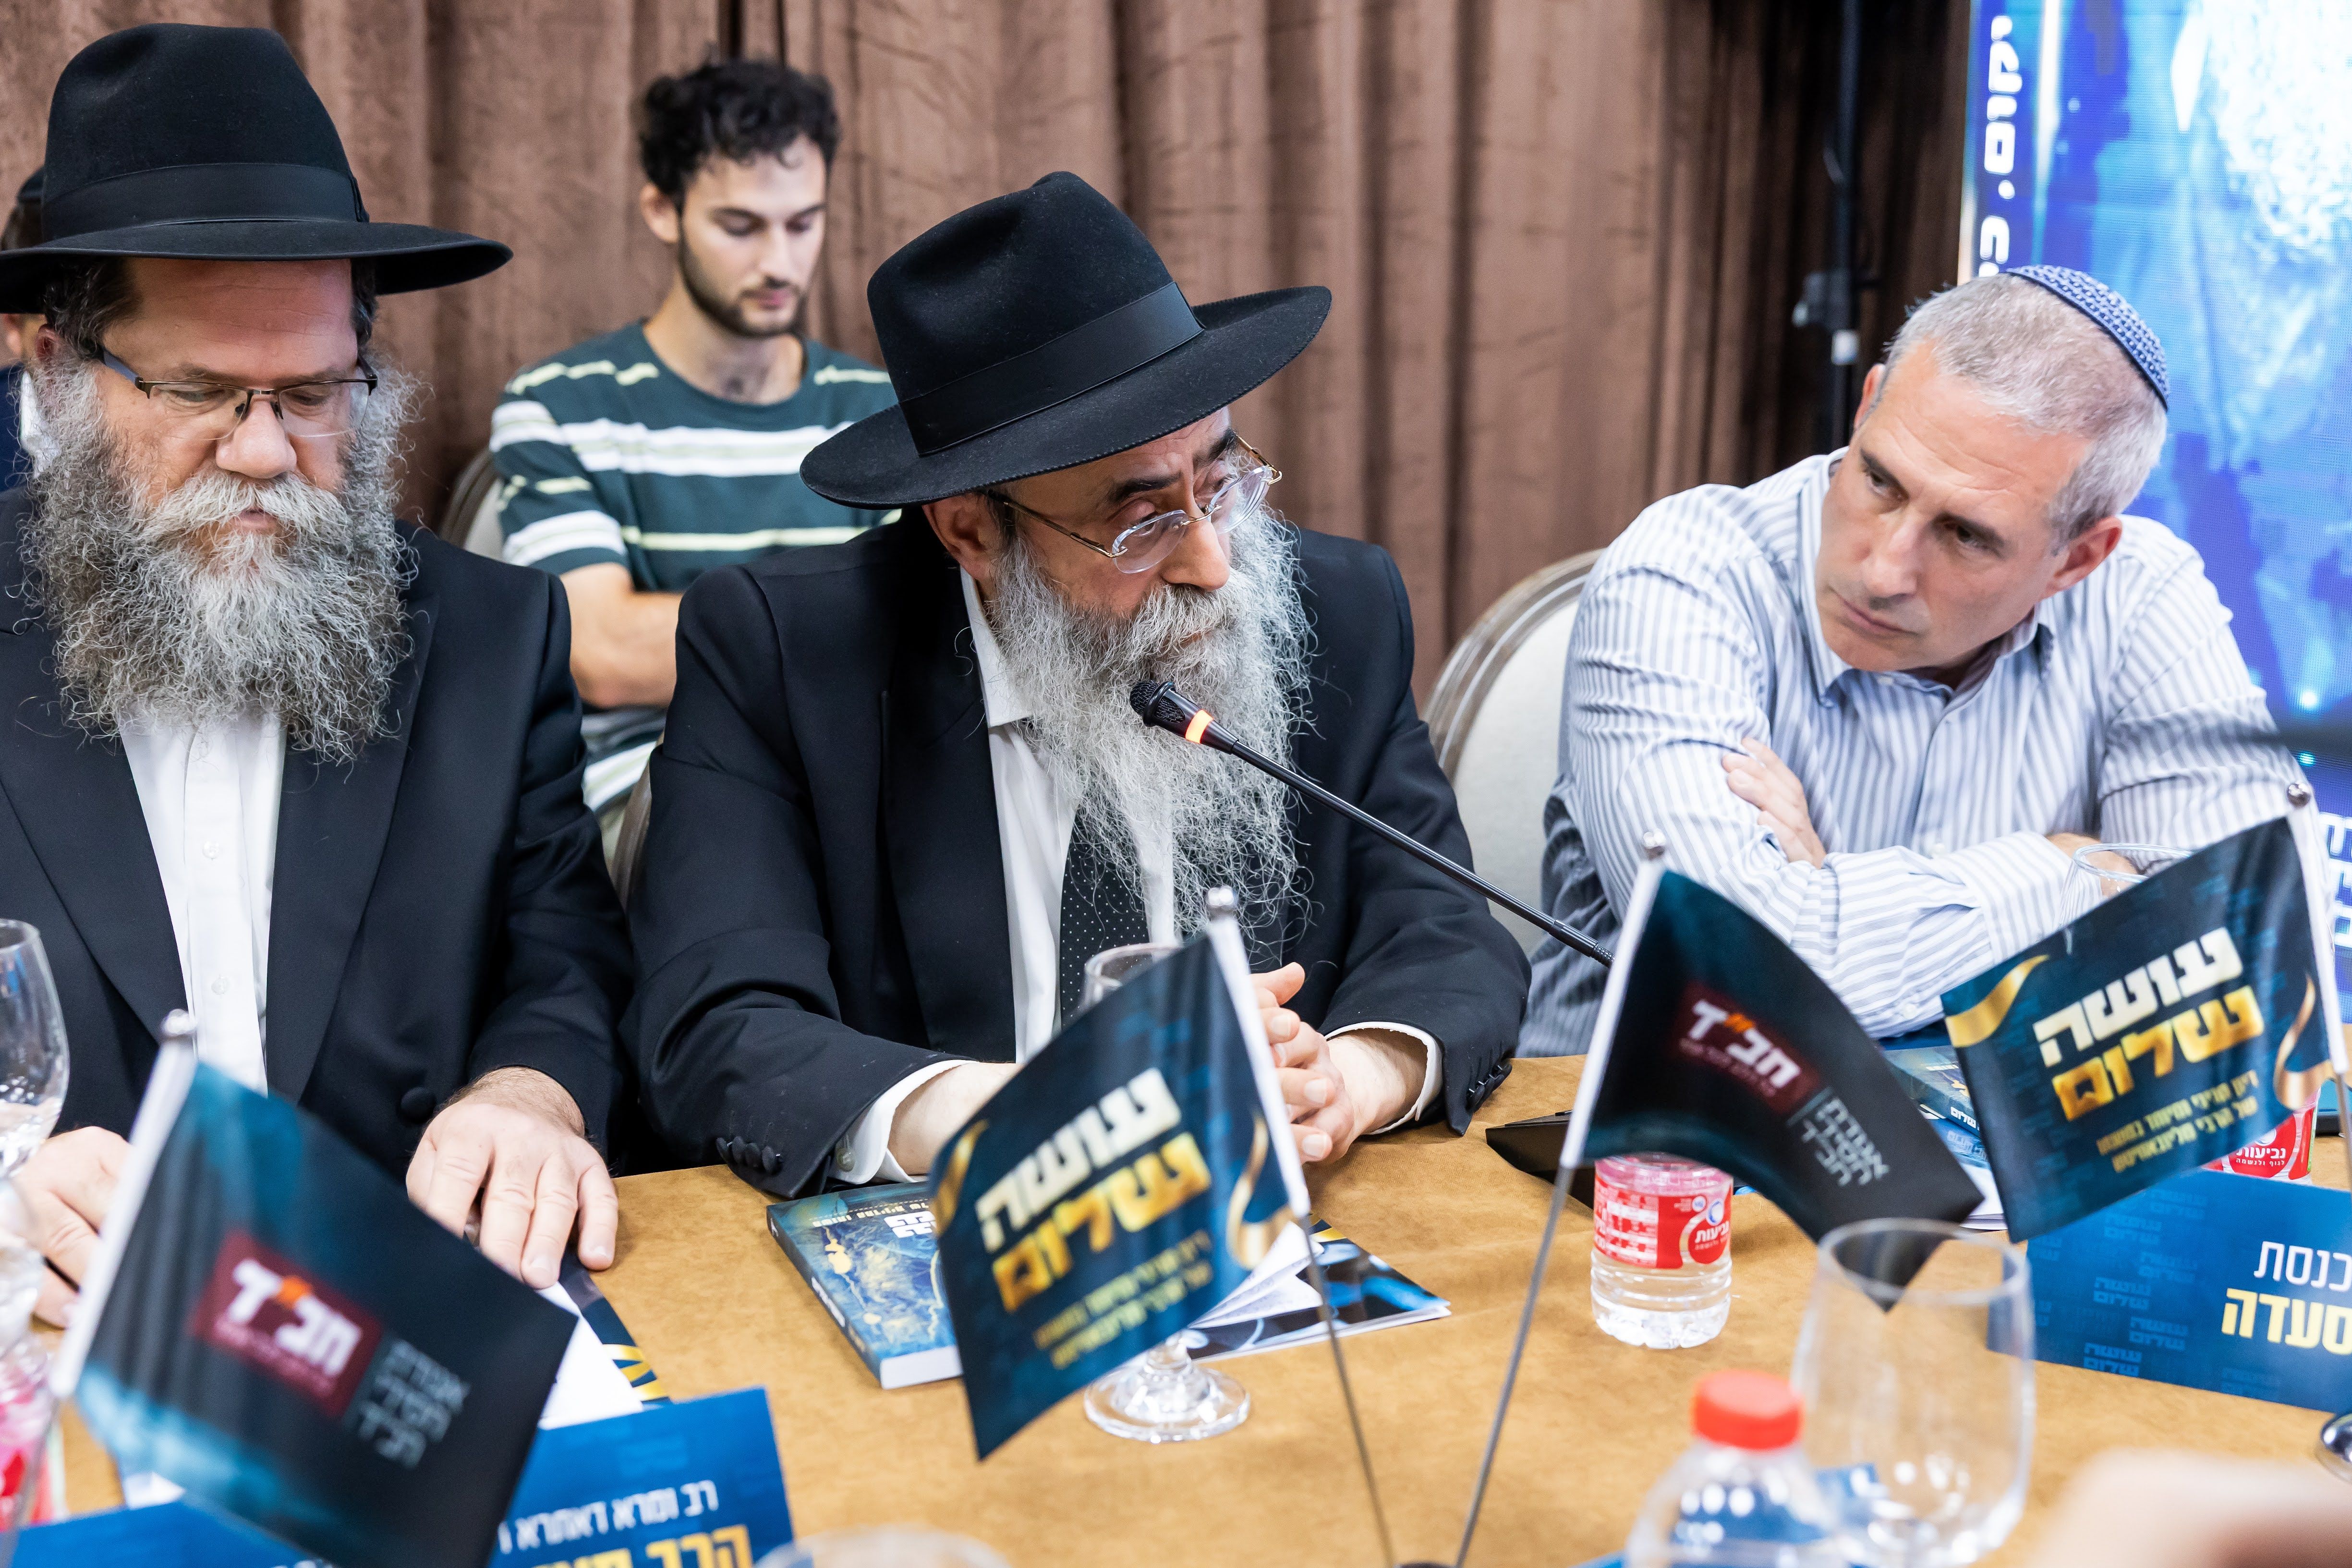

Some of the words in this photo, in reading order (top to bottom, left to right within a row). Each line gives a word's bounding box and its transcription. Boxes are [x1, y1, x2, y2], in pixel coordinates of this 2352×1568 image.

[1691, 997, 1800, 1087] חב"ד
[2033, 927, 2243, 1068] עושה
[2052, 985, 2264, 1121] שלום
[976, 1068, 1181, 1252] עושה
[1950, 1106, 1976, 1129] שלום
[2236, 1146, 2286, 1159] נביעות
[992, 1132, 1212, 1312] שלום
[2254, 1241, 2352, 1292] כנסת
[2221, 1288, 2352, 1355] סעדה
